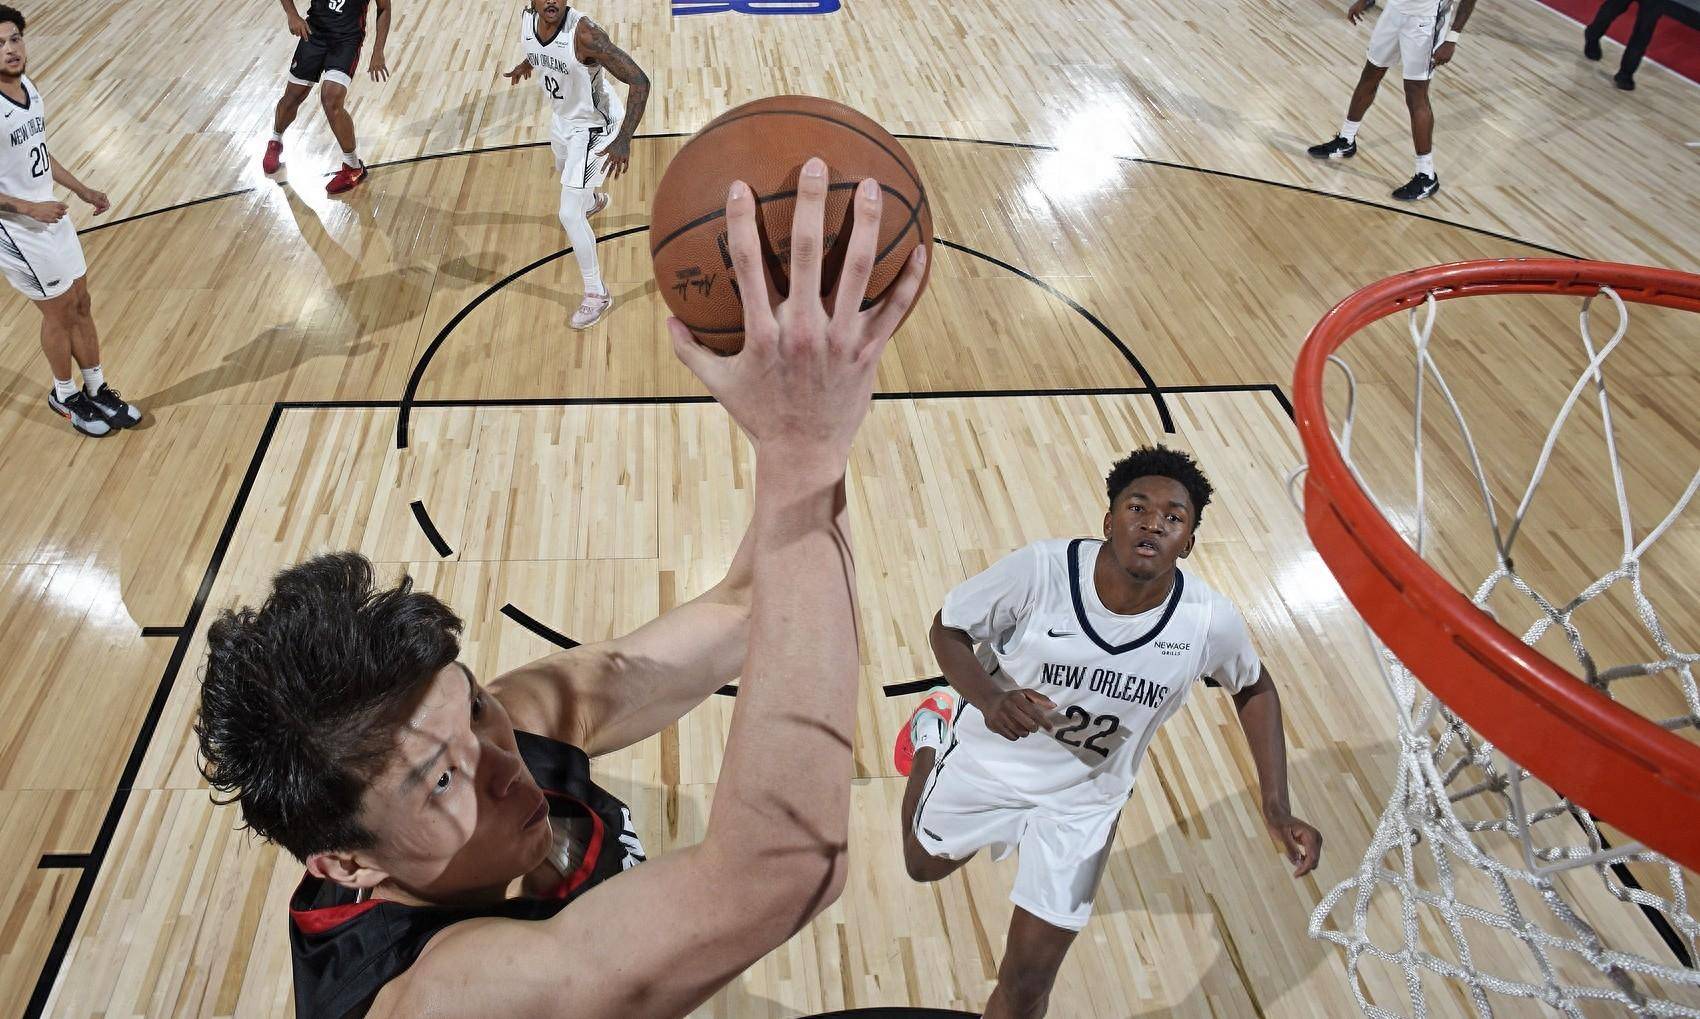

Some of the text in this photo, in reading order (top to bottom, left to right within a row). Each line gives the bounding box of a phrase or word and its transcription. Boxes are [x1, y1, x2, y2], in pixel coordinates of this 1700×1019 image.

[540, 54, 569, 75] ORLEANS
[10, 121, 29, 147] NEW
[30, 142, 50, 178] 20
[1154, 641, 1191, 651] NEWAGE
[1041, 662, 1168, 709] NEW ORLEANS
[1055, 705, 1120, 758] 22
